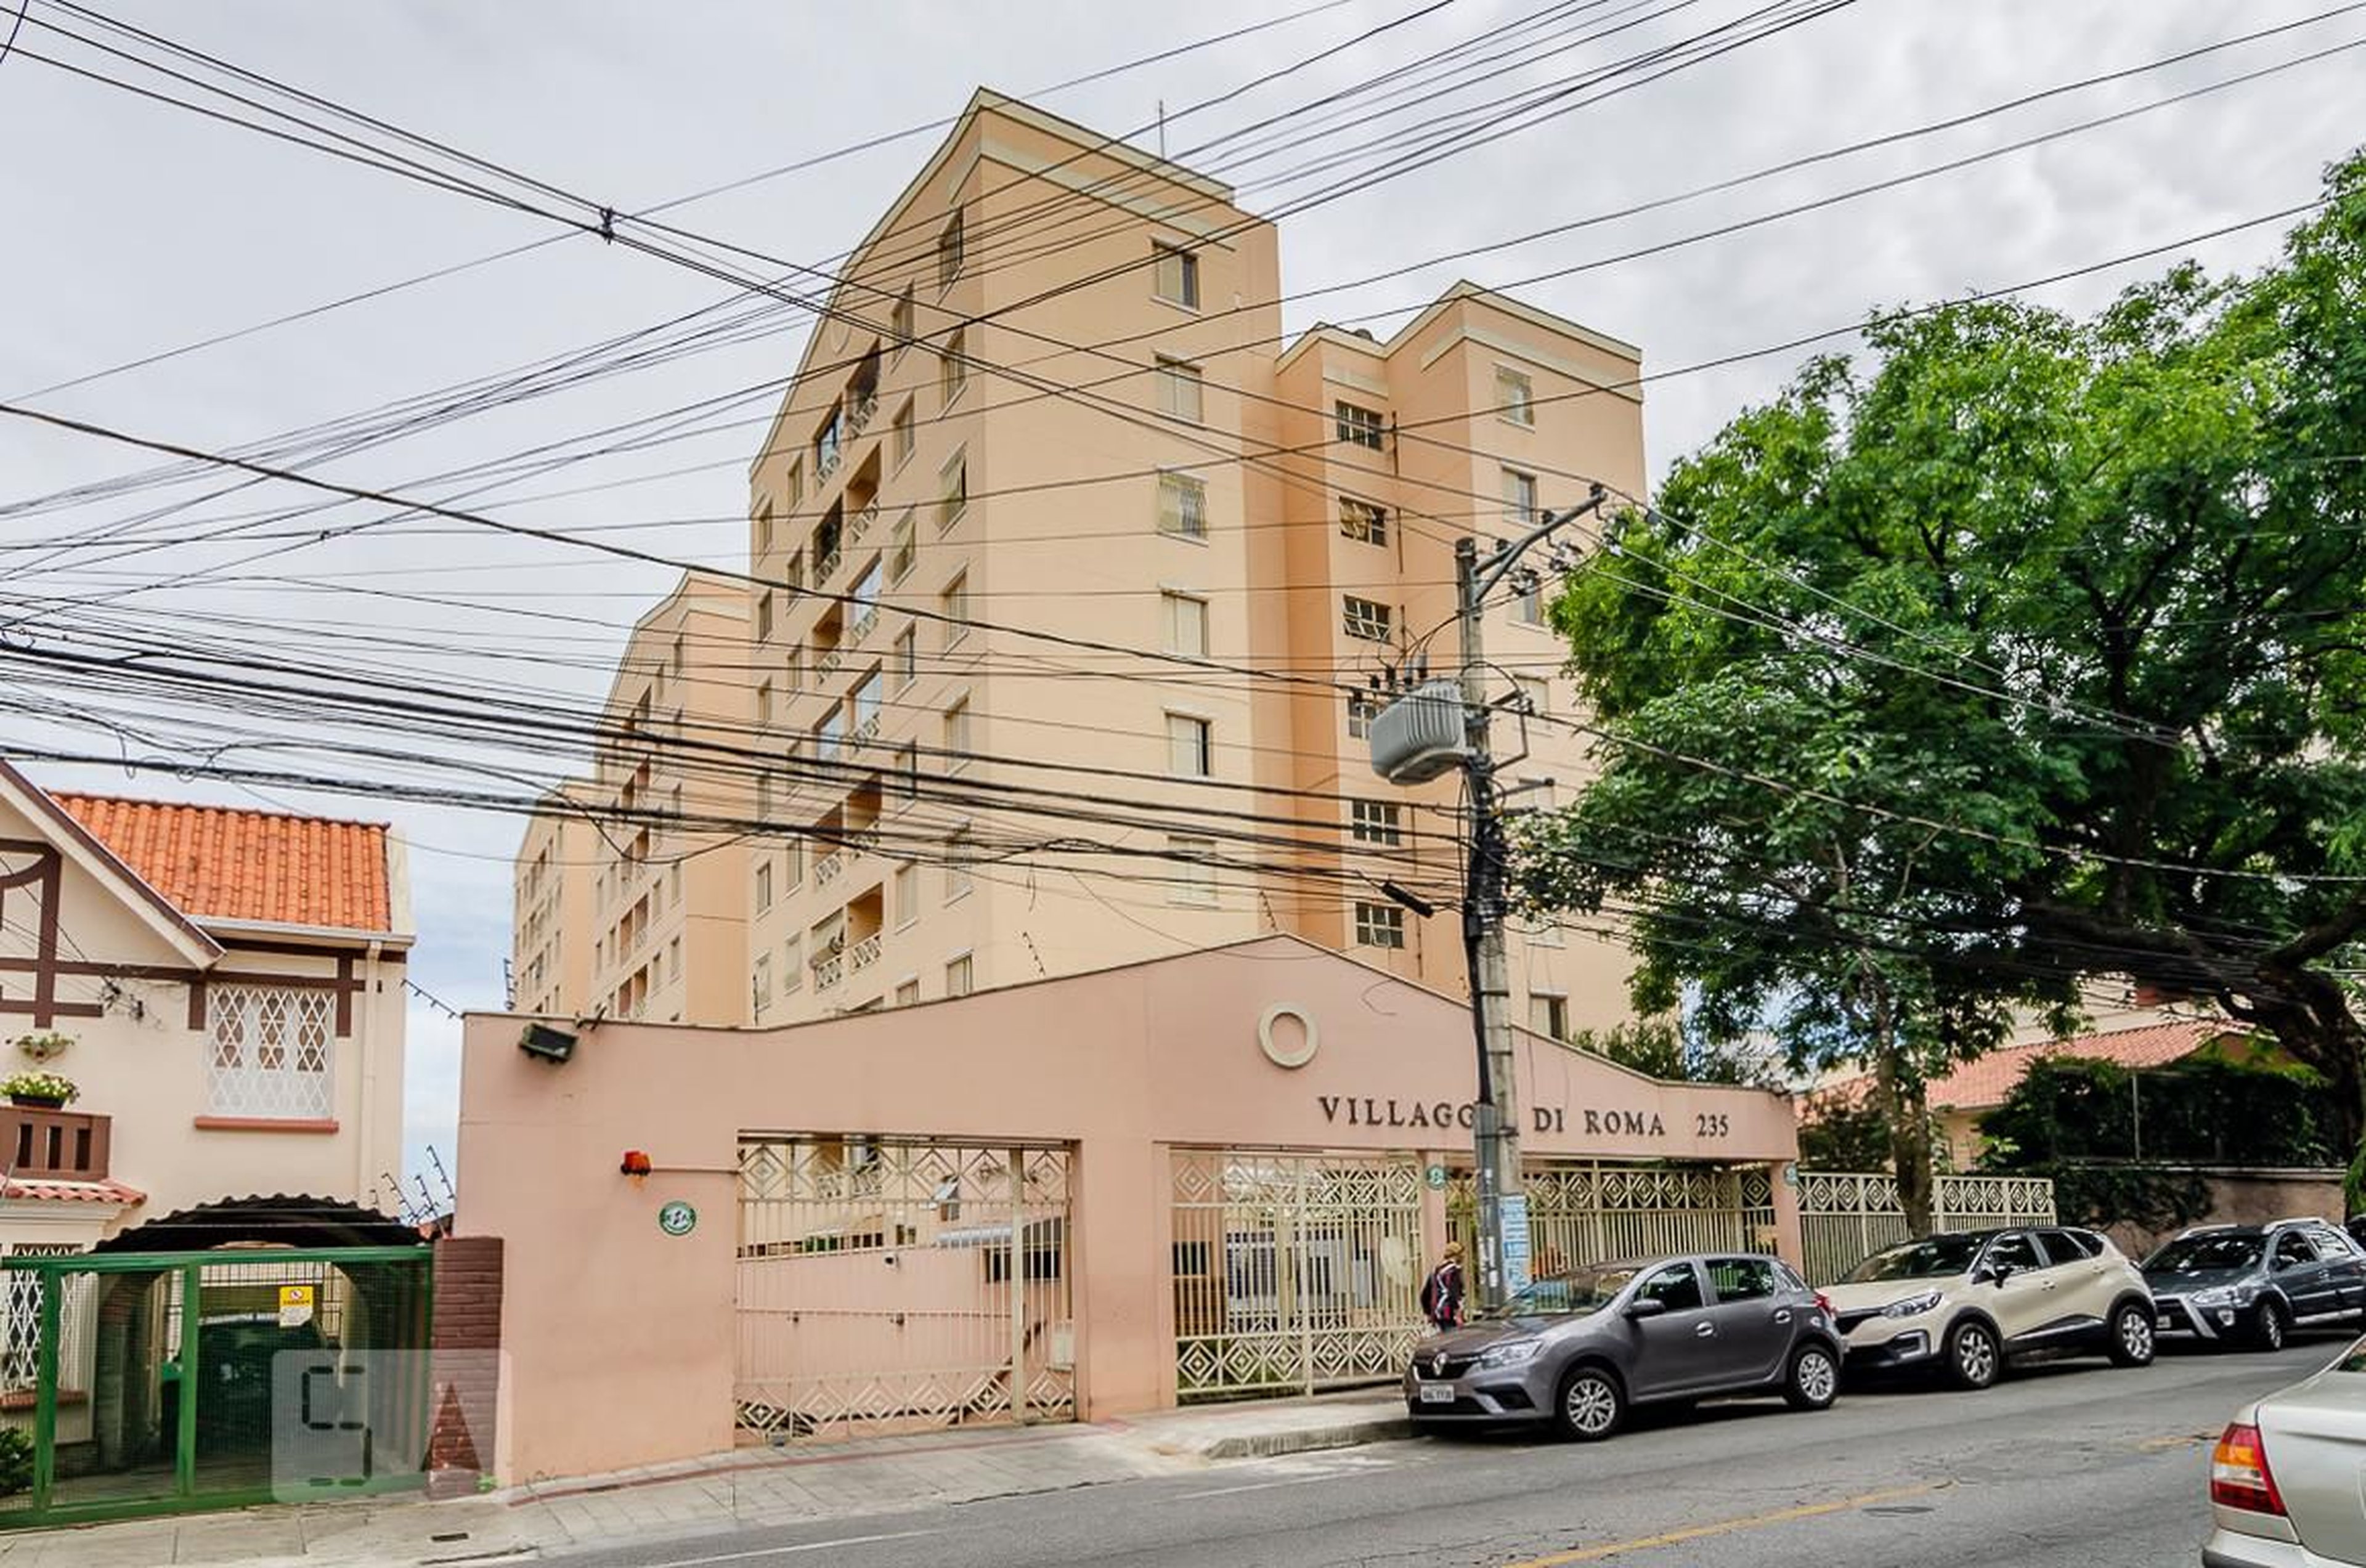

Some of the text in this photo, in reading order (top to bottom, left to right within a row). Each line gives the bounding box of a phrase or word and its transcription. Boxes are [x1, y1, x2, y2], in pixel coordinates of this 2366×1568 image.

[1532, 1107, 1564, 1133] DI
[1584, 1109, 1665, 1136] ROMA
[1696, 1113, 1729, 1137] 235
